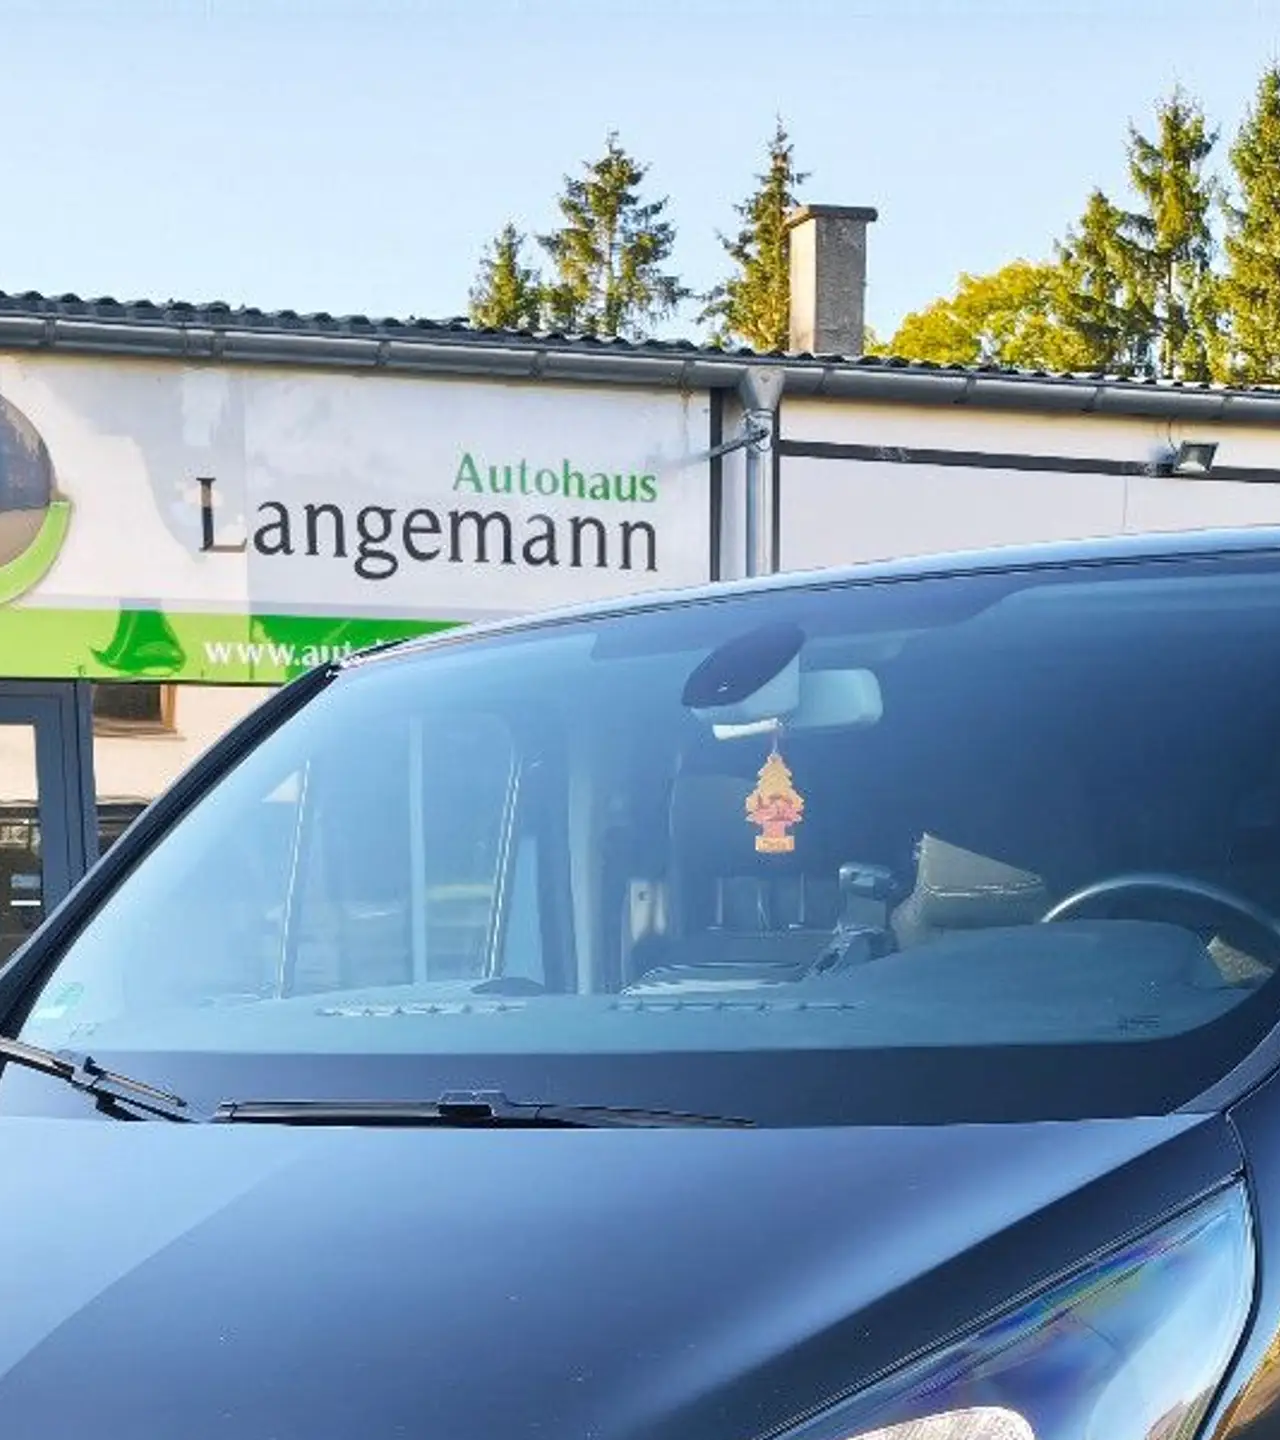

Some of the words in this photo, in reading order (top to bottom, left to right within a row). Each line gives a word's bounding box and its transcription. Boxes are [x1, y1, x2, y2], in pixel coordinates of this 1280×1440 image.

[451, 452, 658, 503] Autohaus
[195, 476, 659, 581] Langemann
[204, 637, 384, 669] www.aut
